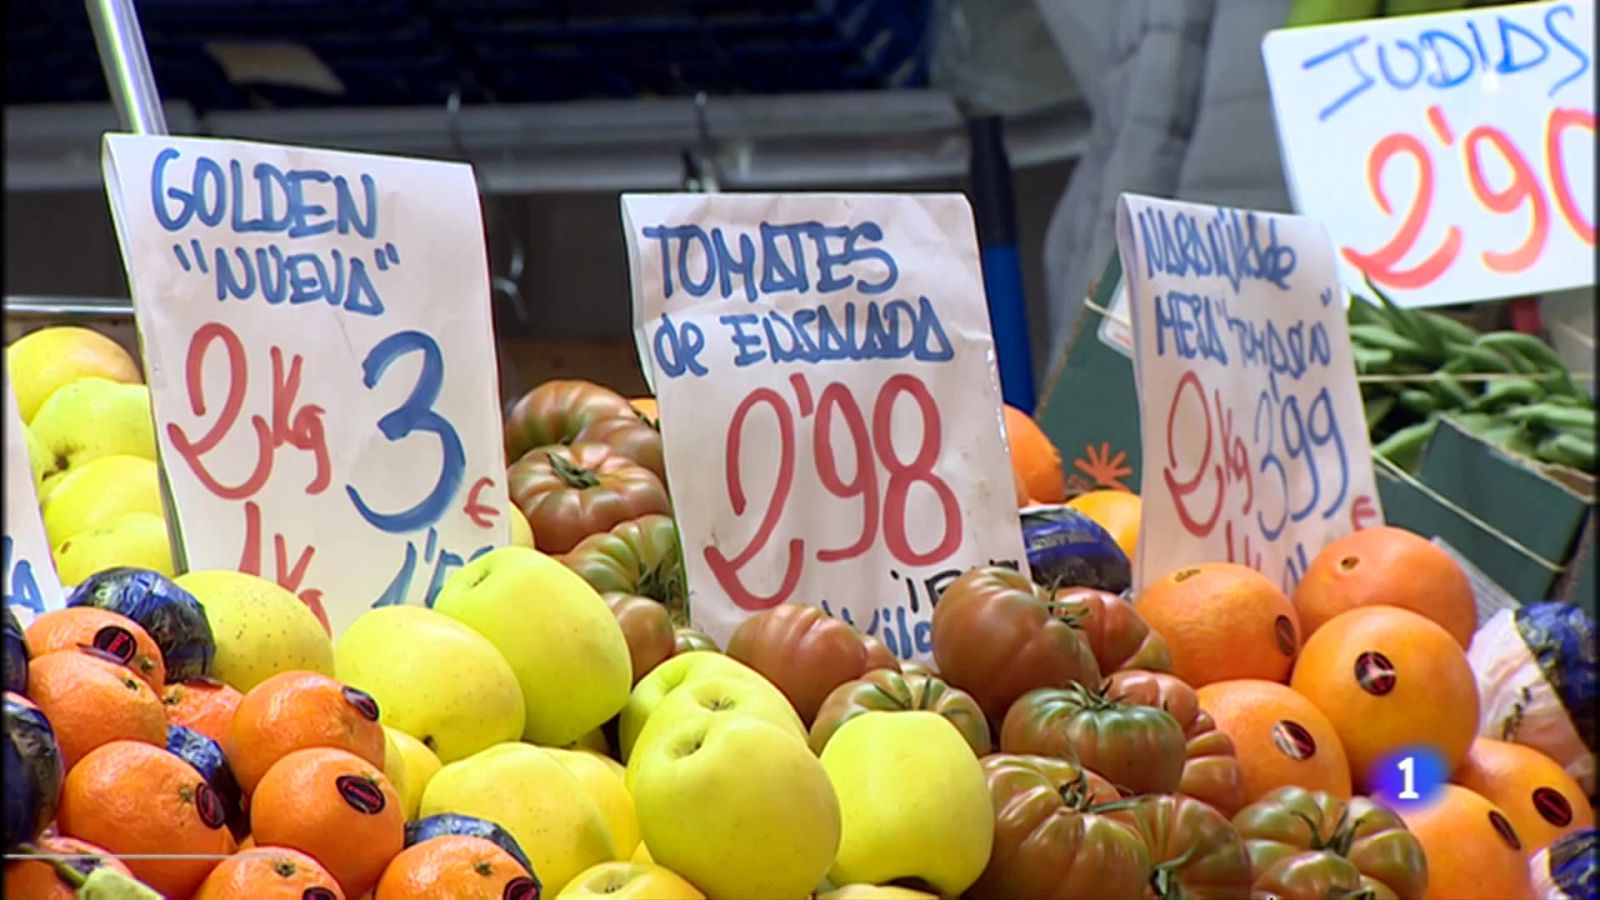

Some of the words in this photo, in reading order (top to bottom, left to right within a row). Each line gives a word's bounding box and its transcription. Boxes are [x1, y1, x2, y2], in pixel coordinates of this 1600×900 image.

[151, 148, 377, 239] GOLDEN
[642, 221, 900, 301] TOMATES
[653, 313, 709, 378] de
[704, 372, 963, 612] 2'98
